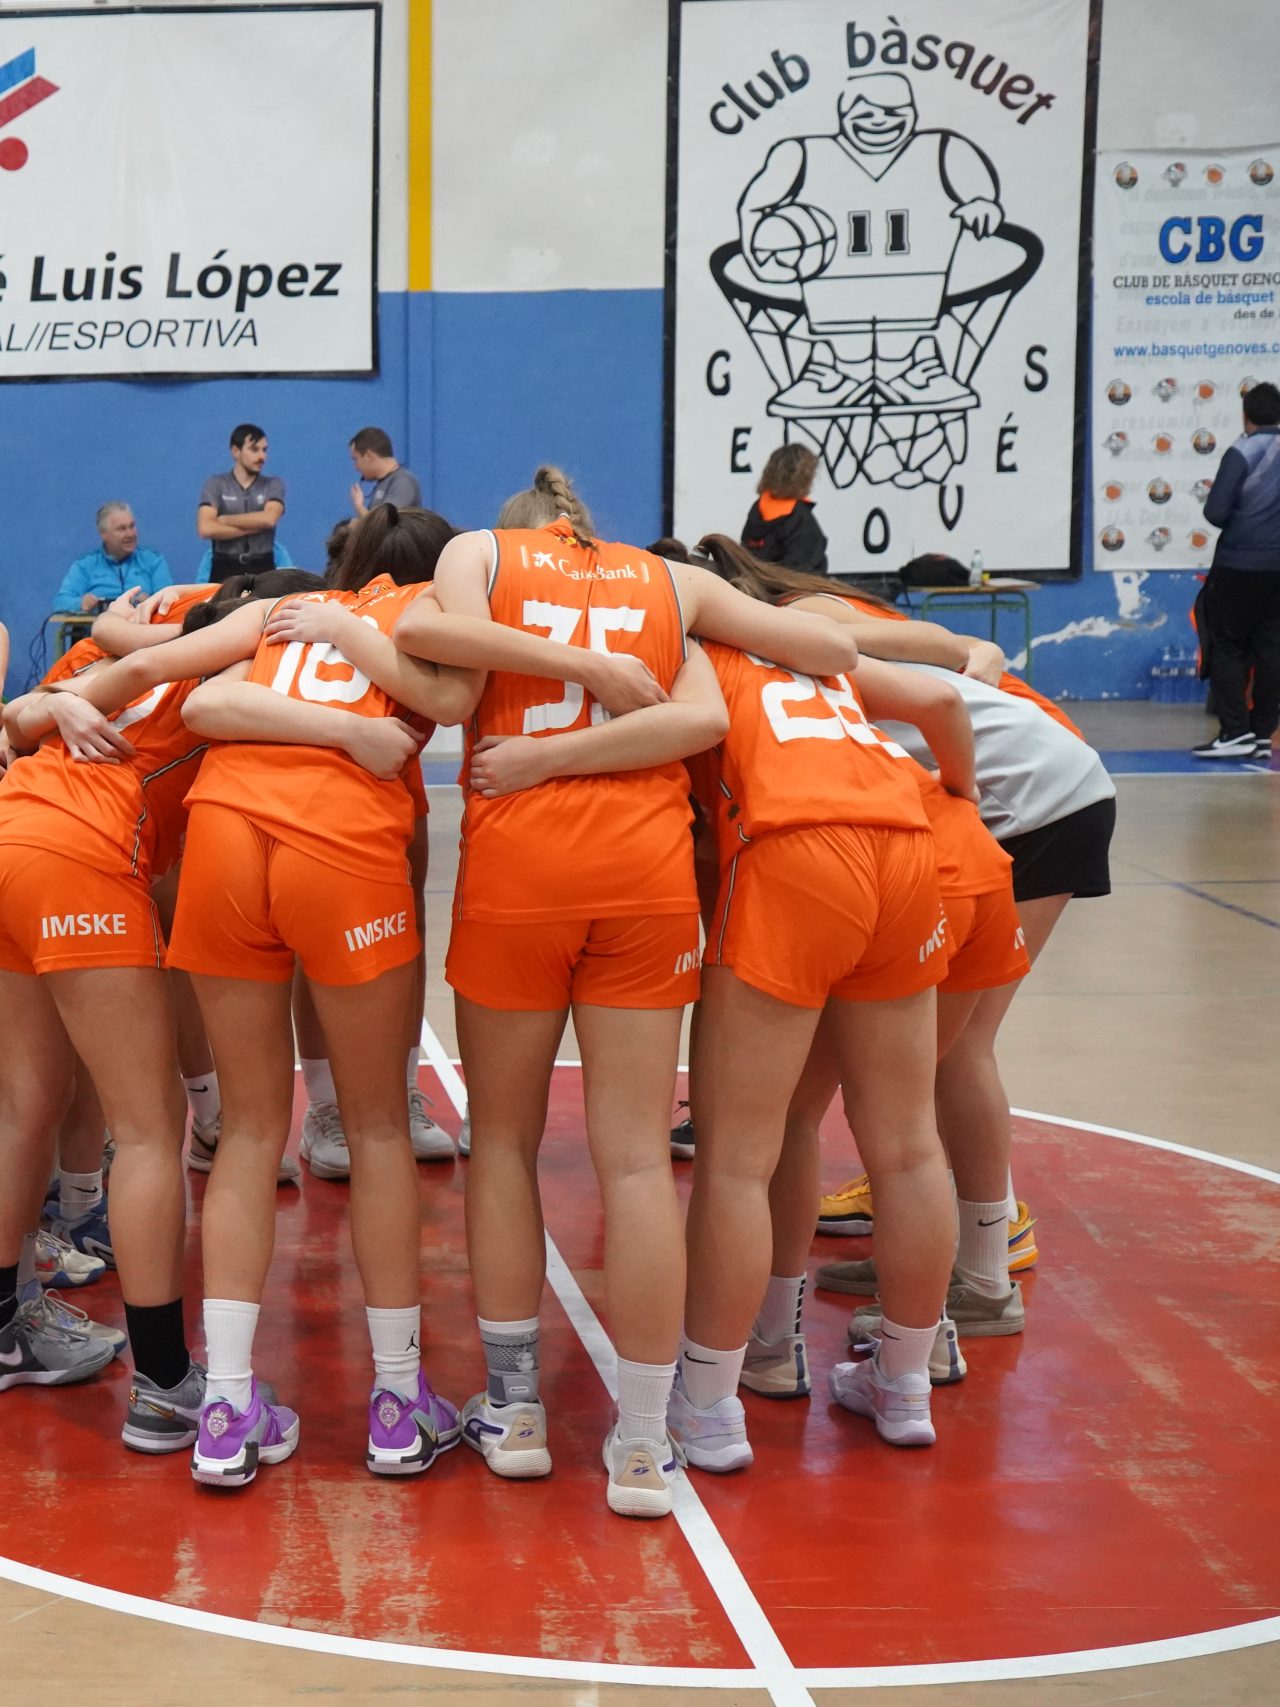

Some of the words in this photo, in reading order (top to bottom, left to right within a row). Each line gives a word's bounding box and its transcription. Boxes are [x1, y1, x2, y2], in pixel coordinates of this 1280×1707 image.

[709, 49, 811, 135] club
[846, 16, 1057, 126] bàsquet
[1158, 213, 1265, 264] CBG
[29, 252, 144, 303] Luis
[166, 248, 343, 313] López
[1113, 275, 1149, 289] CLUB
[1152, 275, 1171, 288] DE
[1146, 290, 1191, 305] escola
[1195, 290, 1213, 304] de
[1234, 308, 1256, 319] des
[1260, 307, 1274, 319] de
[41, 913, 127, 939] IMSKE
[344, 911, 407, 952] IMSKE
